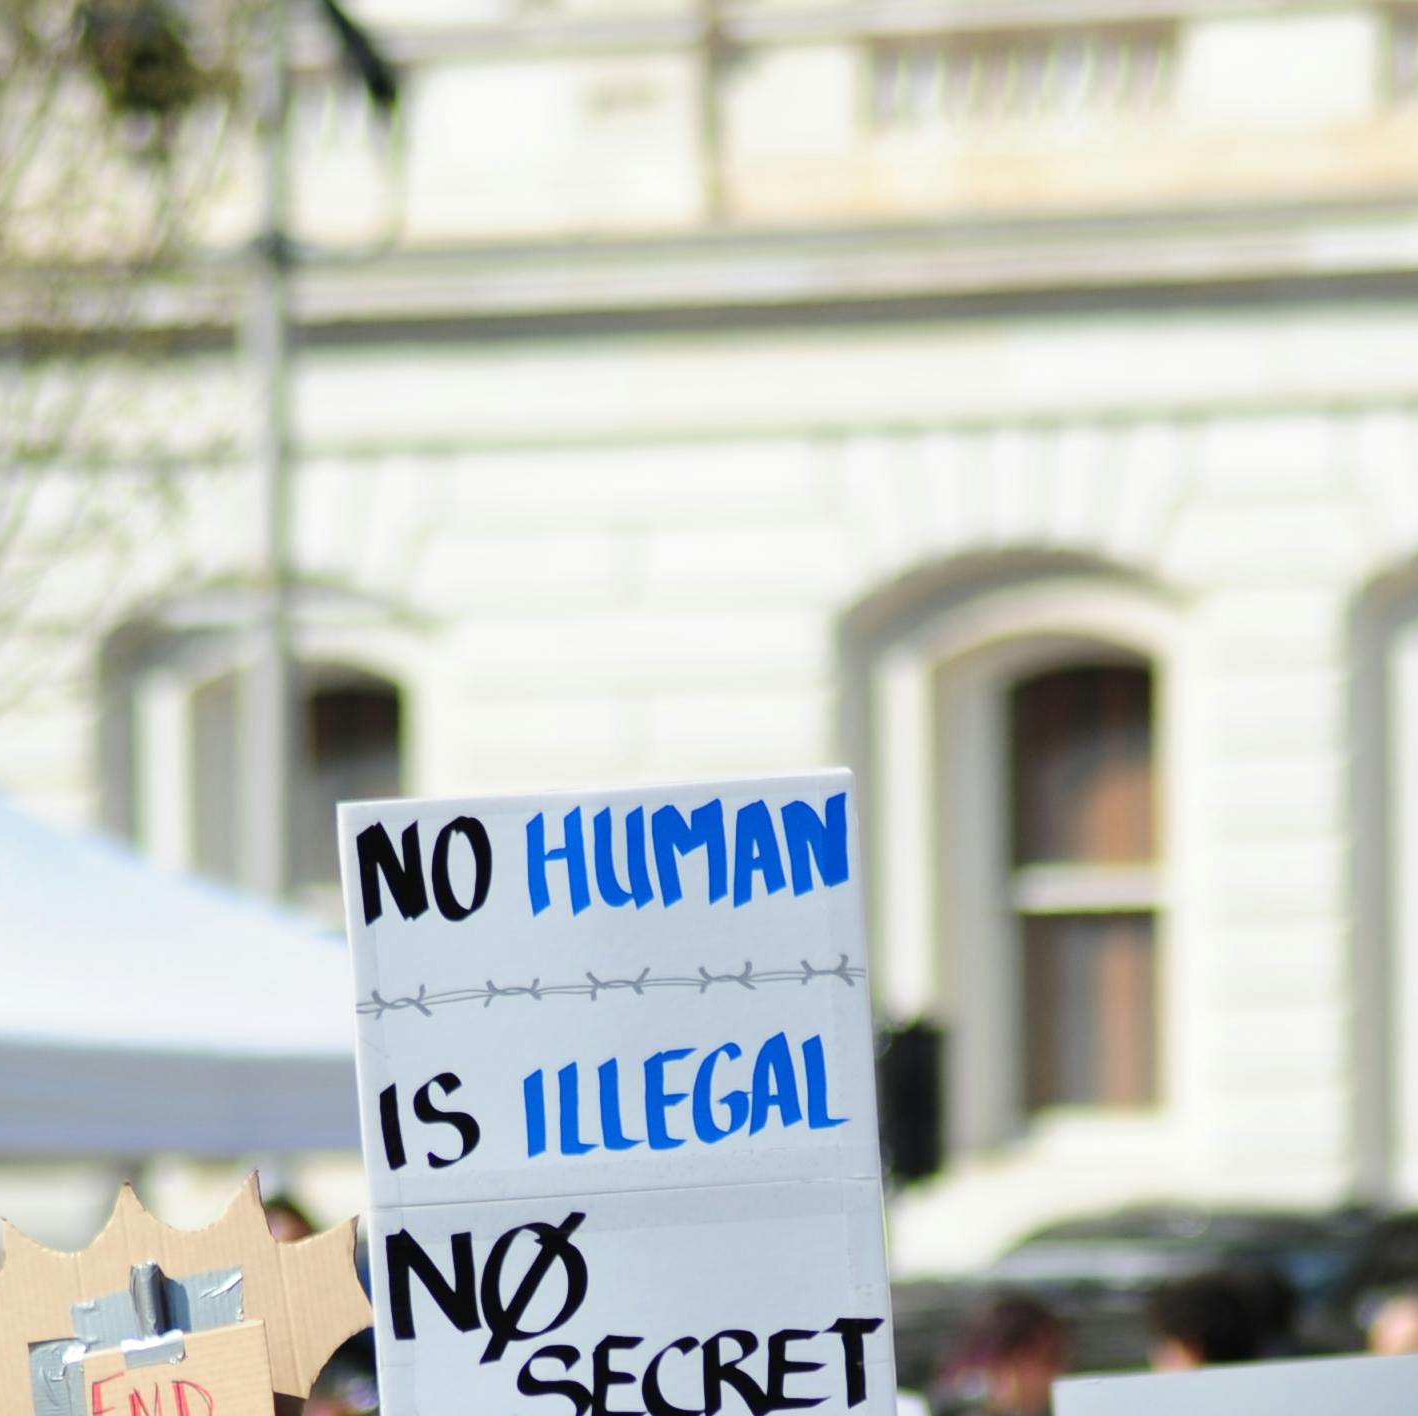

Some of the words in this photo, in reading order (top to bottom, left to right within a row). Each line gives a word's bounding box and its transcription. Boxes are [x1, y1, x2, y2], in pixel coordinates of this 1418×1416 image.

[355, 815, 492, 924] NO
[525, 791, 849, 917] HUMAN
[379, 1071, 481, 1171] IS
[522, 1030, 850, 1159] ILLEGAL
